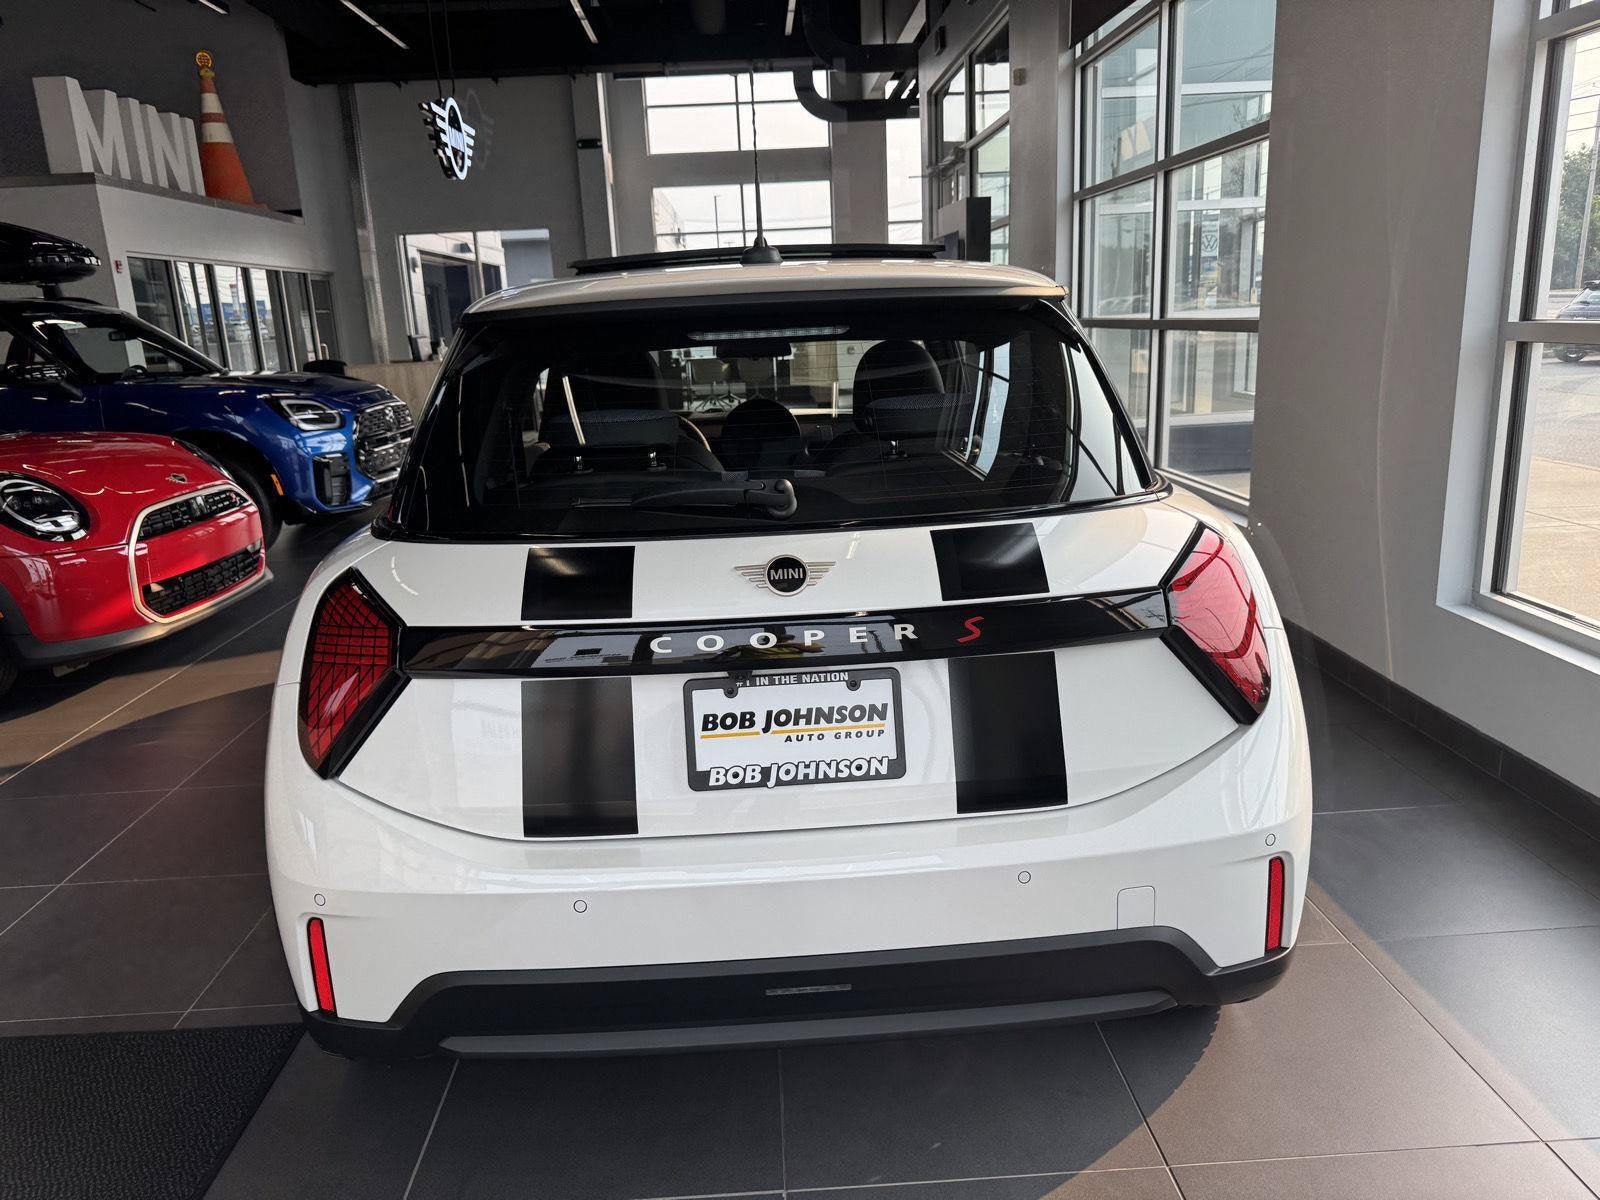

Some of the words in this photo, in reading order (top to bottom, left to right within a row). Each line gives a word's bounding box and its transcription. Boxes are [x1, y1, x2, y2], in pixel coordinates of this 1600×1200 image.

[62, 75, 206, 198] MINI
[769, 567, 804, 581] MINI
[649, 623, 919, 654] COOPER
[957, 615, 985, 644] S
[755, 677, 769, 686] IN
[773, 674, 798, 685] THE
[802, 671, 849, 683] NATION
[701, 710, 756, 732] BOB
[762, 702, 889, 734] JOHNSON
[784, 733, 825, 743] AUTO
[834, 729, 886, 740] GROUP
[708, 764, 762, 787] BOB
[766, 756, 890, 789] JOHNSON
